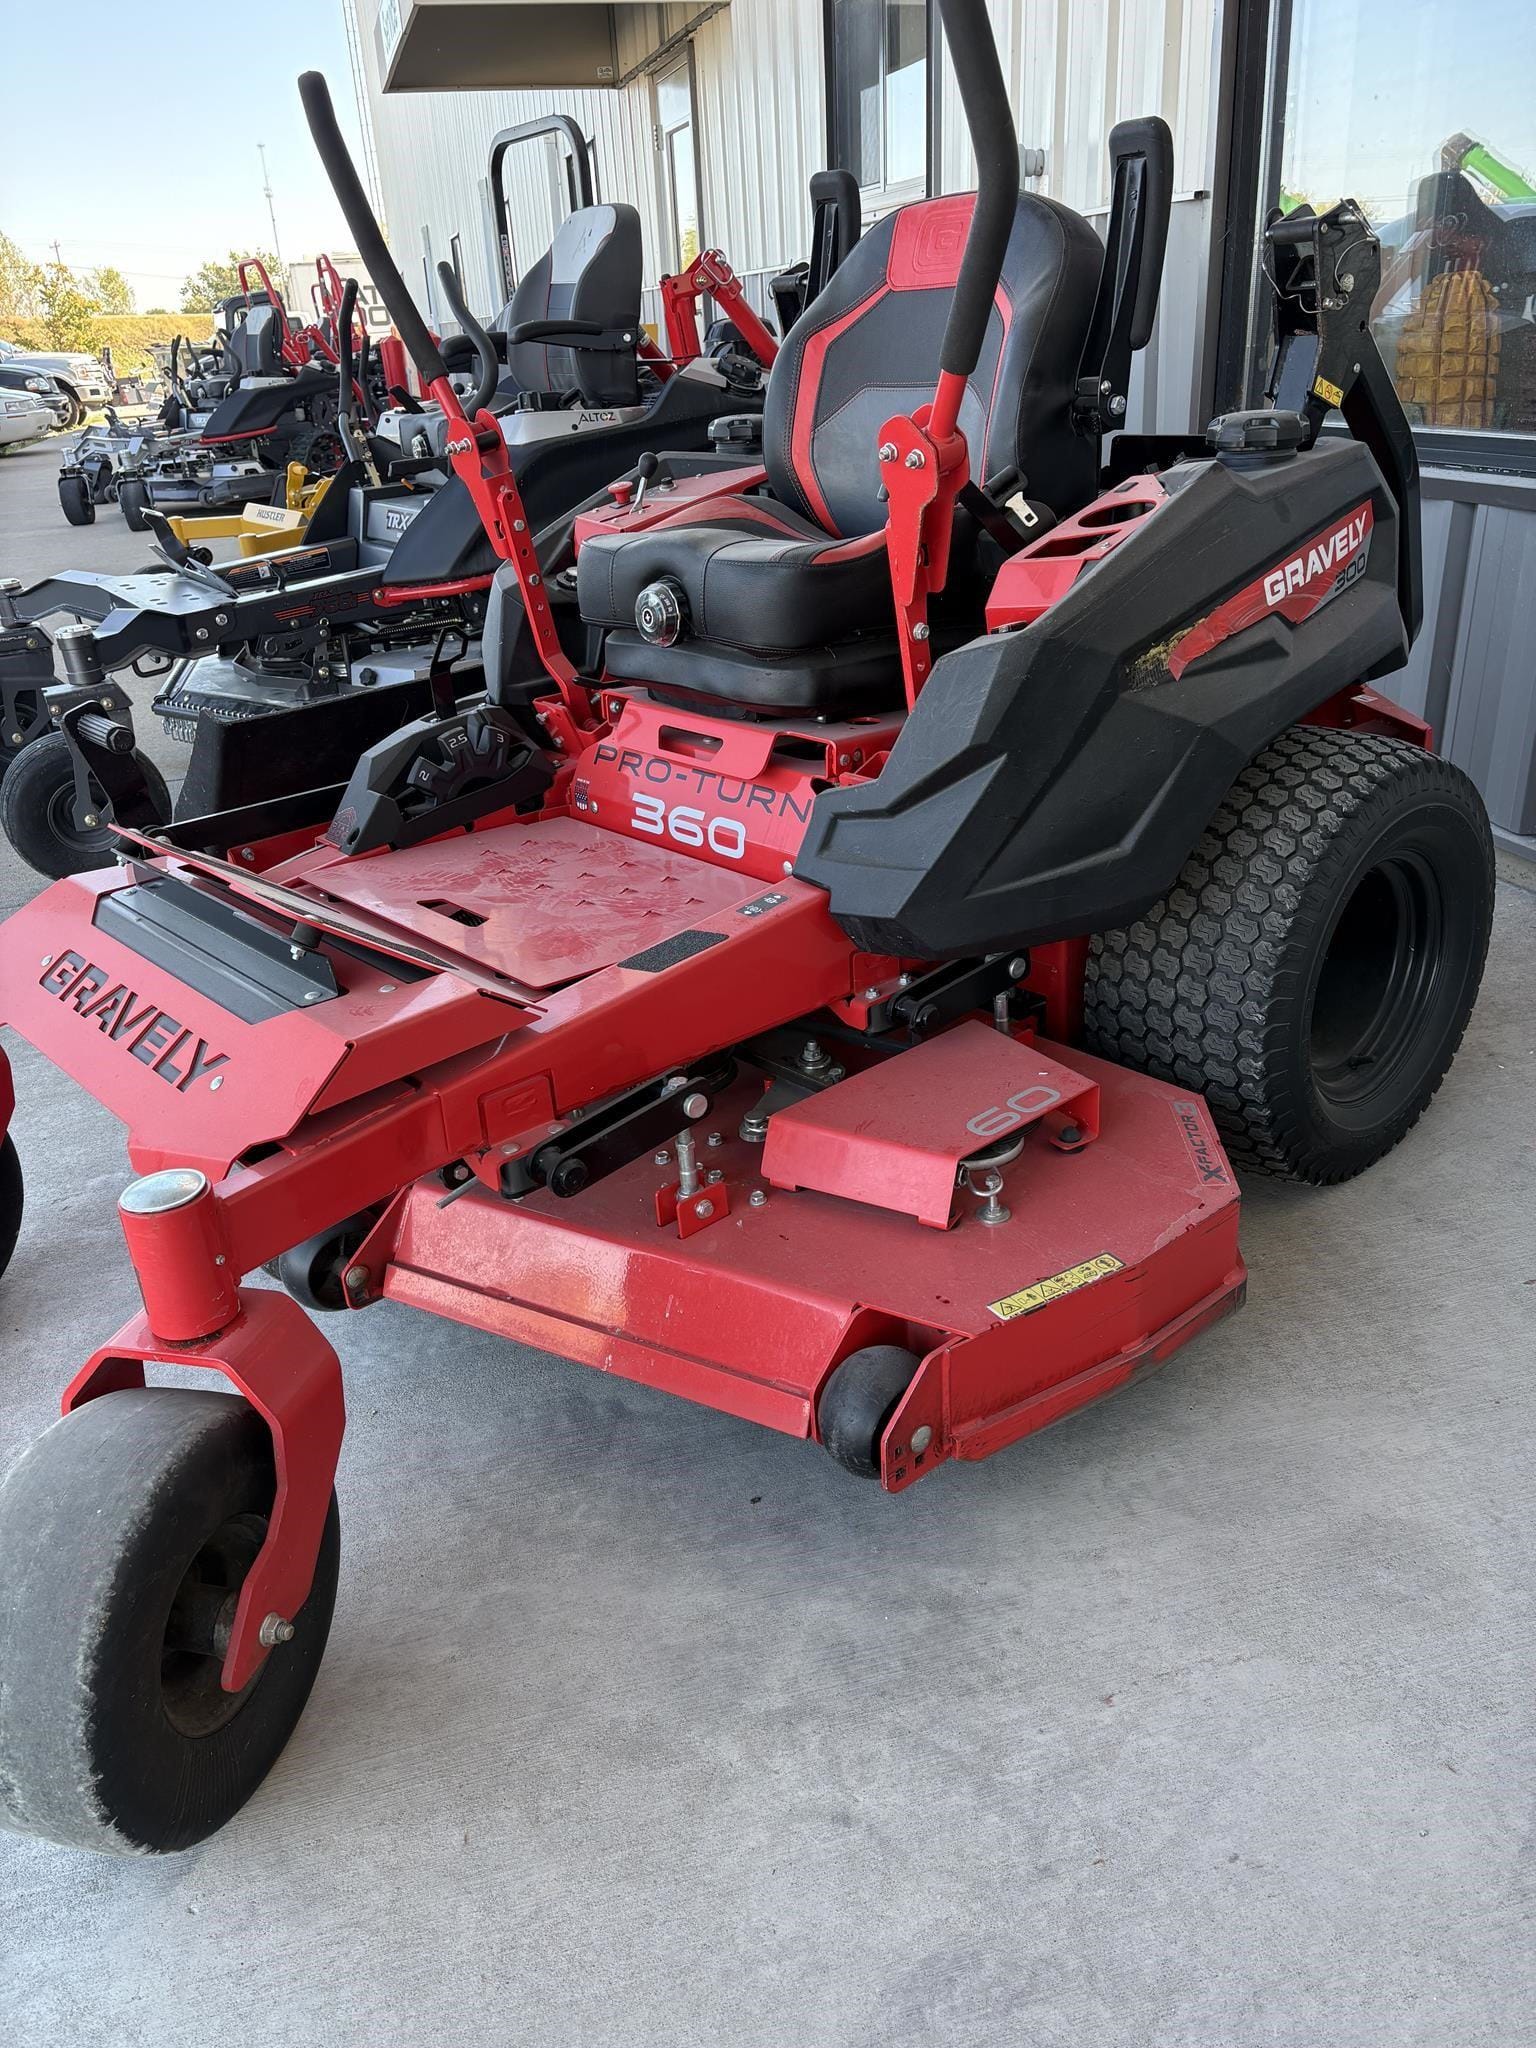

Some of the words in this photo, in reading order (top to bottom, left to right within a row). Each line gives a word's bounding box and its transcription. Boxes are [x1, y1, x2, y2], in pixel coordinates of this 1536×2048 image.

[256, 509, 286, 522] HUSTLER
[387, 511, 410, 531] TRX
[1263, 510, 1367, 607] GRAVELY
[447, 732, 468, 749] 2.5
[496, 732, 505, 744] 3
[418, 769, 430, 781] 2
[593, 743, 812, 824] PRO-TURN
[631, 791, 747, 860] 360
[39, 948, 231, 1094] GRAVELY
[966, 1085, 1061, 1137] 60
